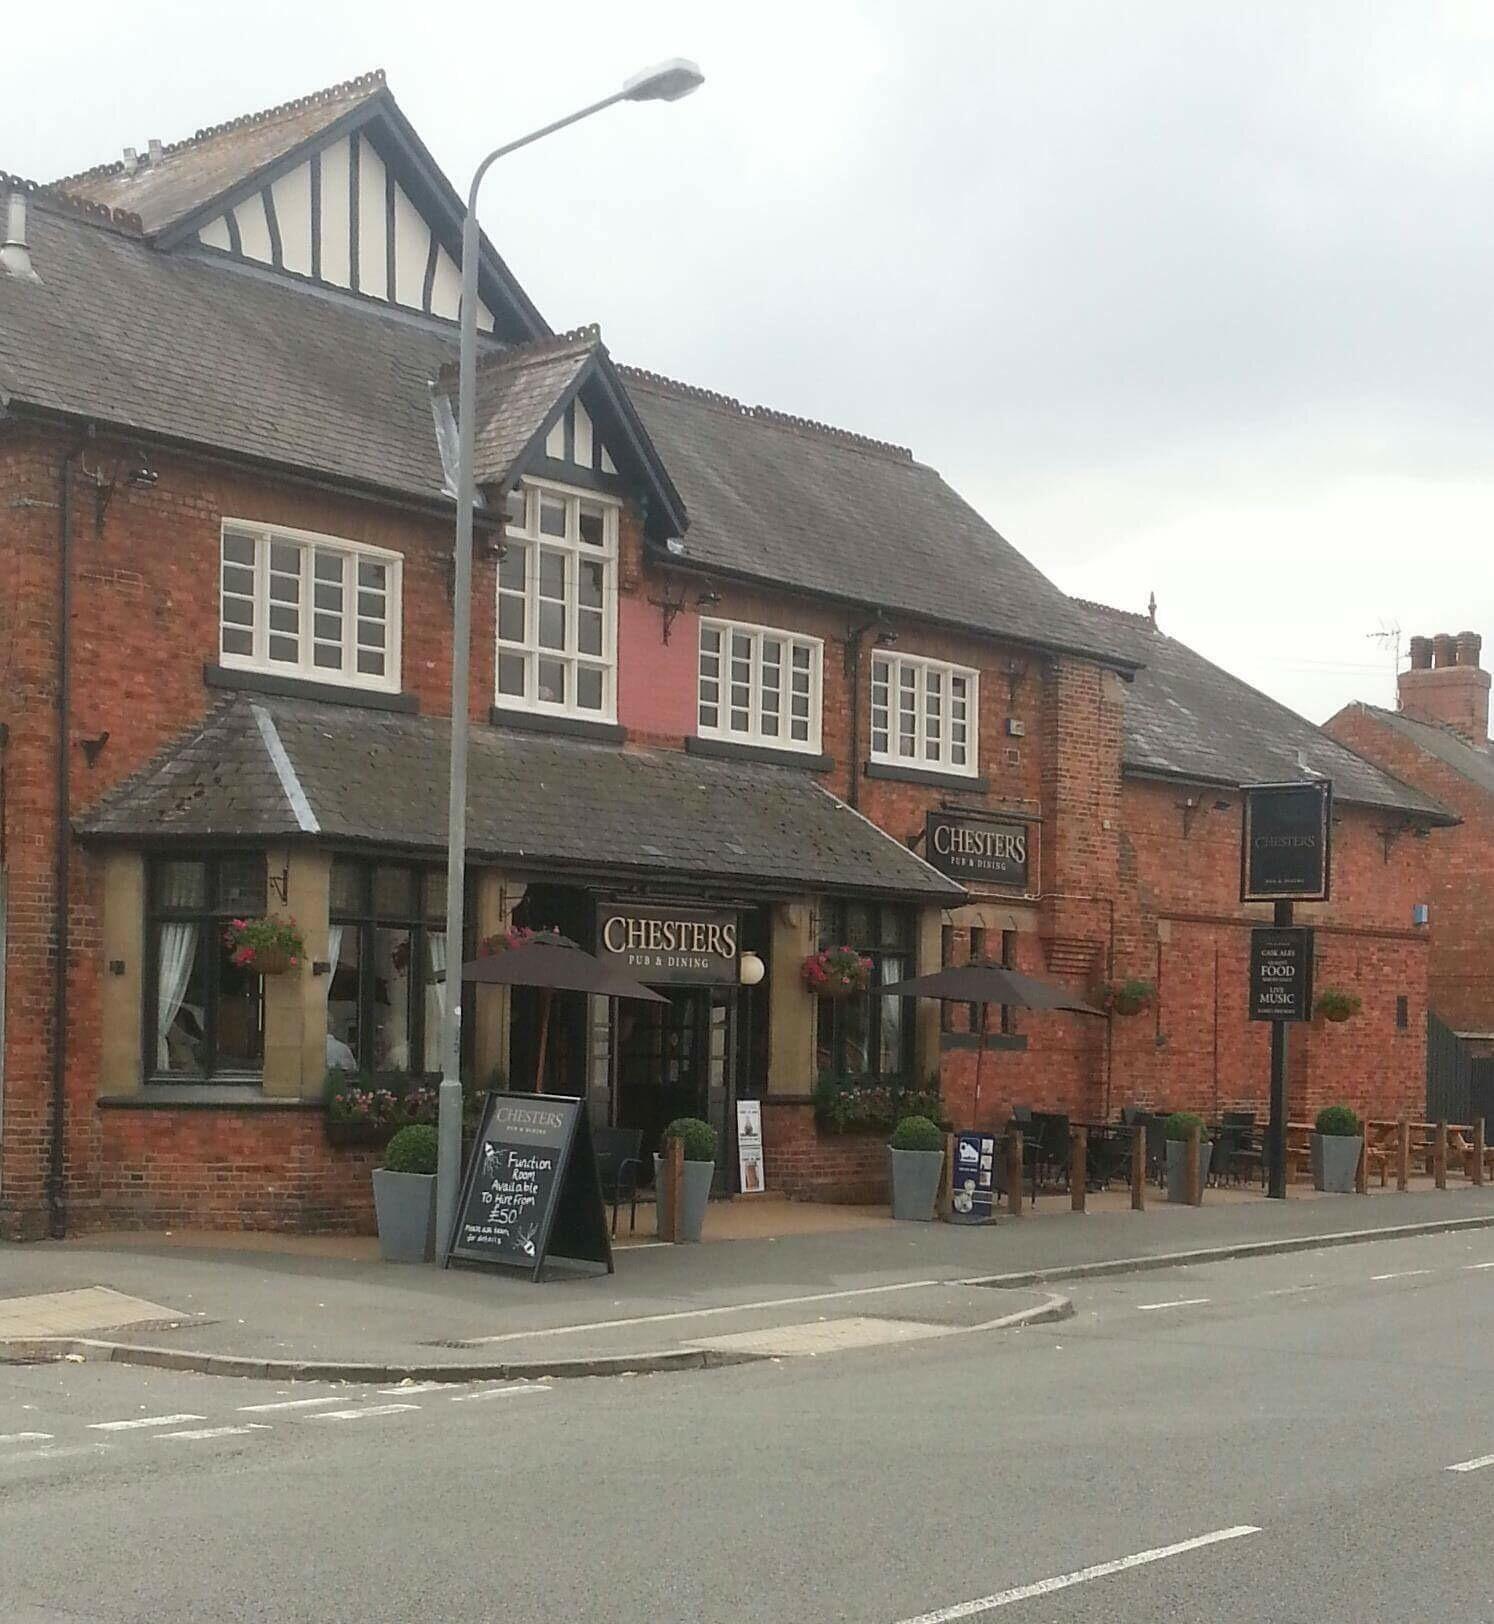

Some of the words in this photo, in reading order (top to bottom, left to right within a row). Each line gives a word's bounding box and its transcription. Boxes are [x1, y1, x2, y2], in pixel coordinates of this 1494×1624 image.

[934, 825, 1026, 864] CHESTERS
[1255, 835, 1315, 848] CHESTERS
[604, 916, 736, 959] CHESTERS
[629, 954, 650, 966] PUB
[656, 957, 662, 966] &
[668, 957, 709, 968] DINING
[1261, 965, 1295, 976] FOOD
[1260, 993, 1295, 1004] MUSIC
[497, 1107, 564, 1128] CHESTERS
[508, 1151, 552, 1171] Function
[513, 1168, 535, 1182] Room
[492, 1179, 538, 1194] Available
[495, 1194, 513, 1206] Hire
